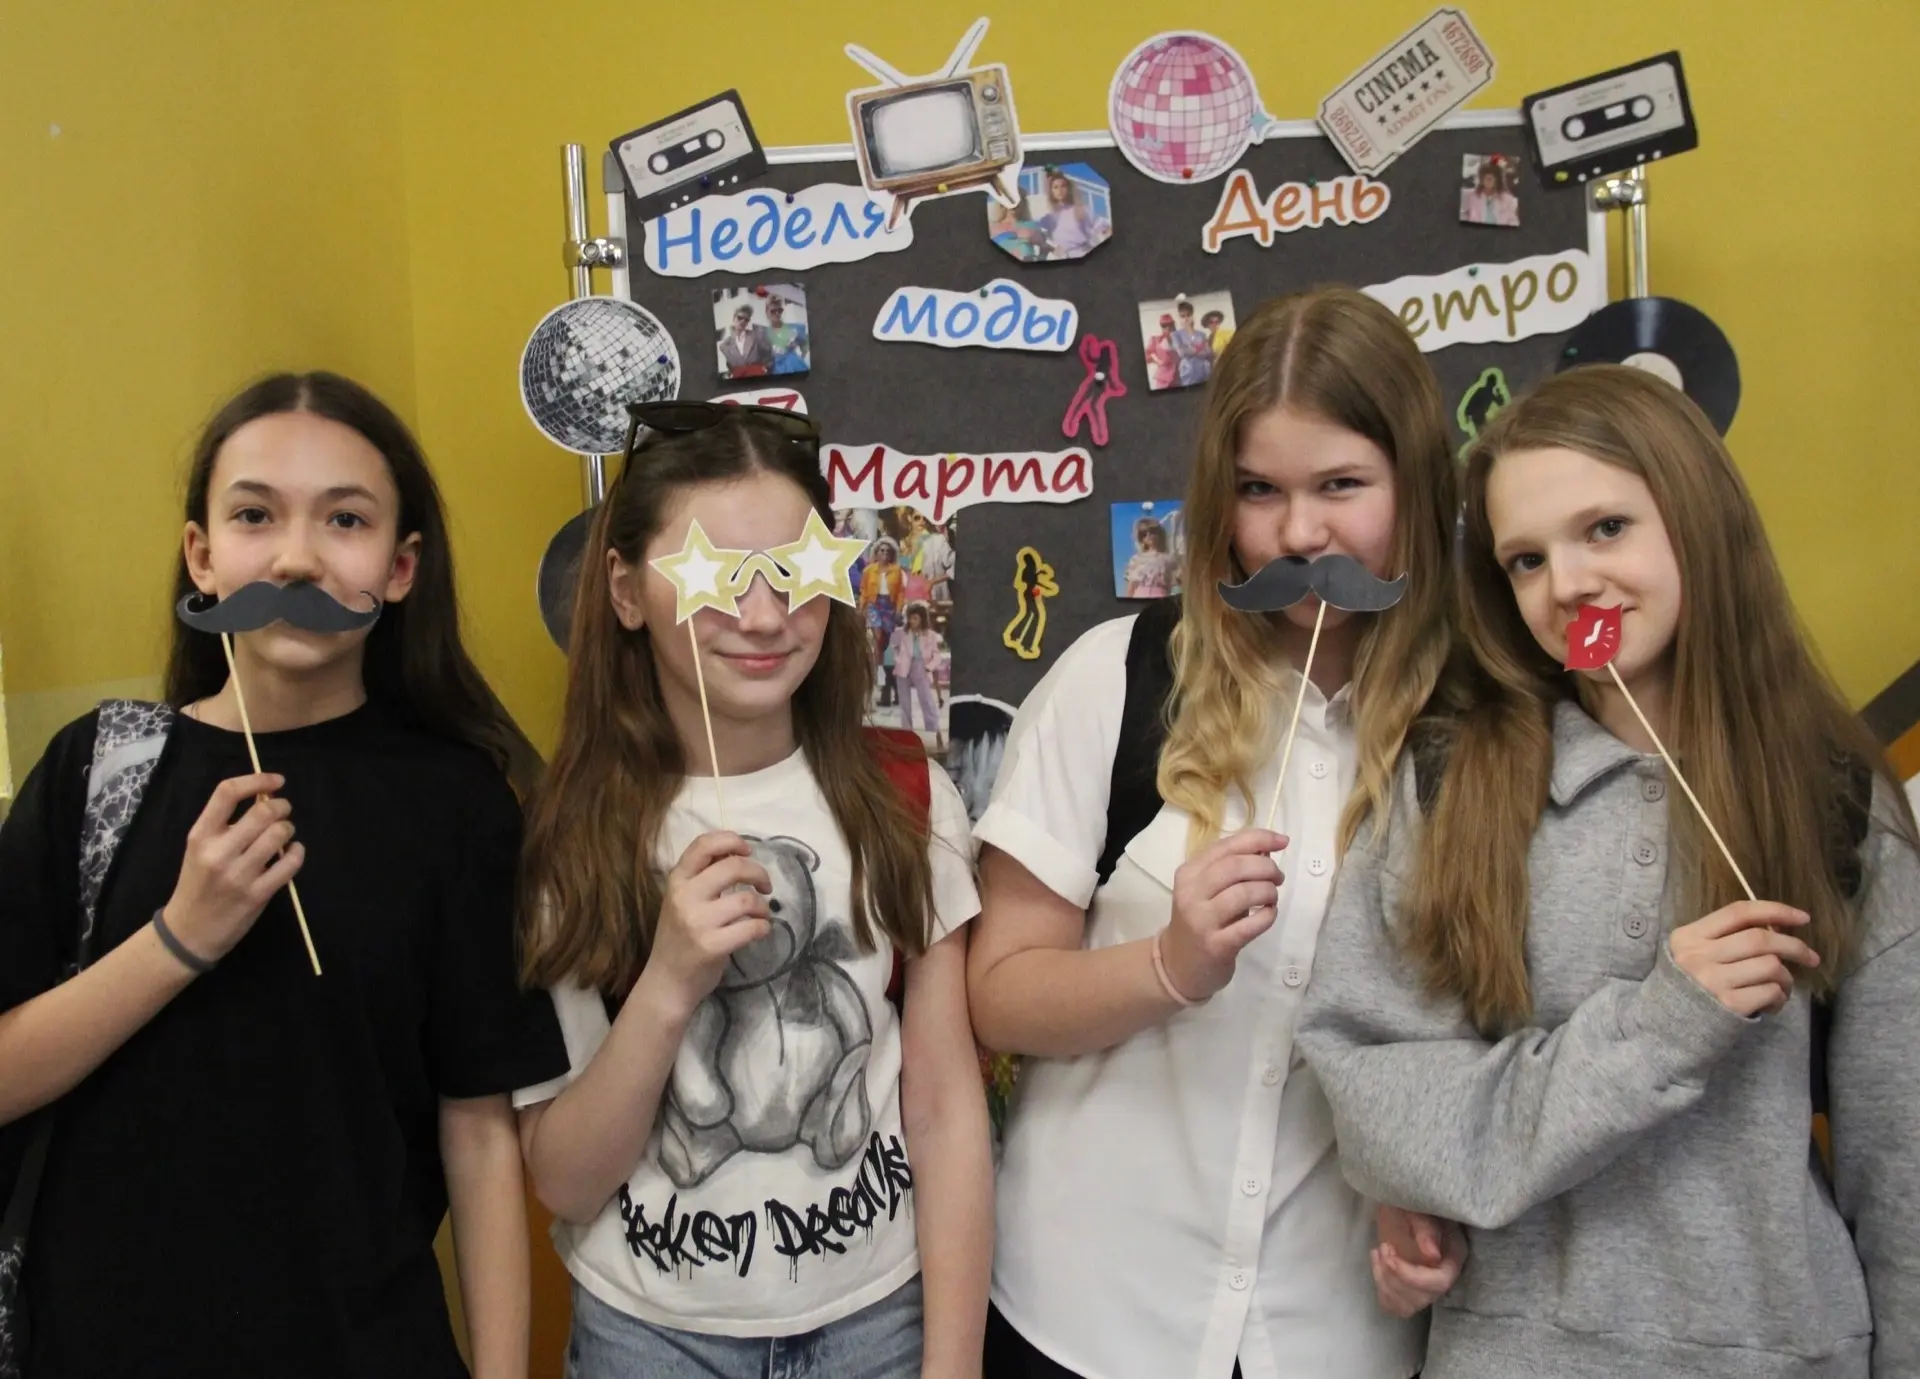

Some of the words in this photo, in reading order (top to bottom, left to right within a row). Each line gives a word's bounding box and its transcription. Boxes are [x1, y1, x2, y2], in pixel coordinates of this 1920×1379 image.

[1354, 39, 1440, 114] CINEMA
[1208, 175, 1386, 249] День
[1399, 262, 1578, 337] етро
[828, 446, 1088, 521] Марта
